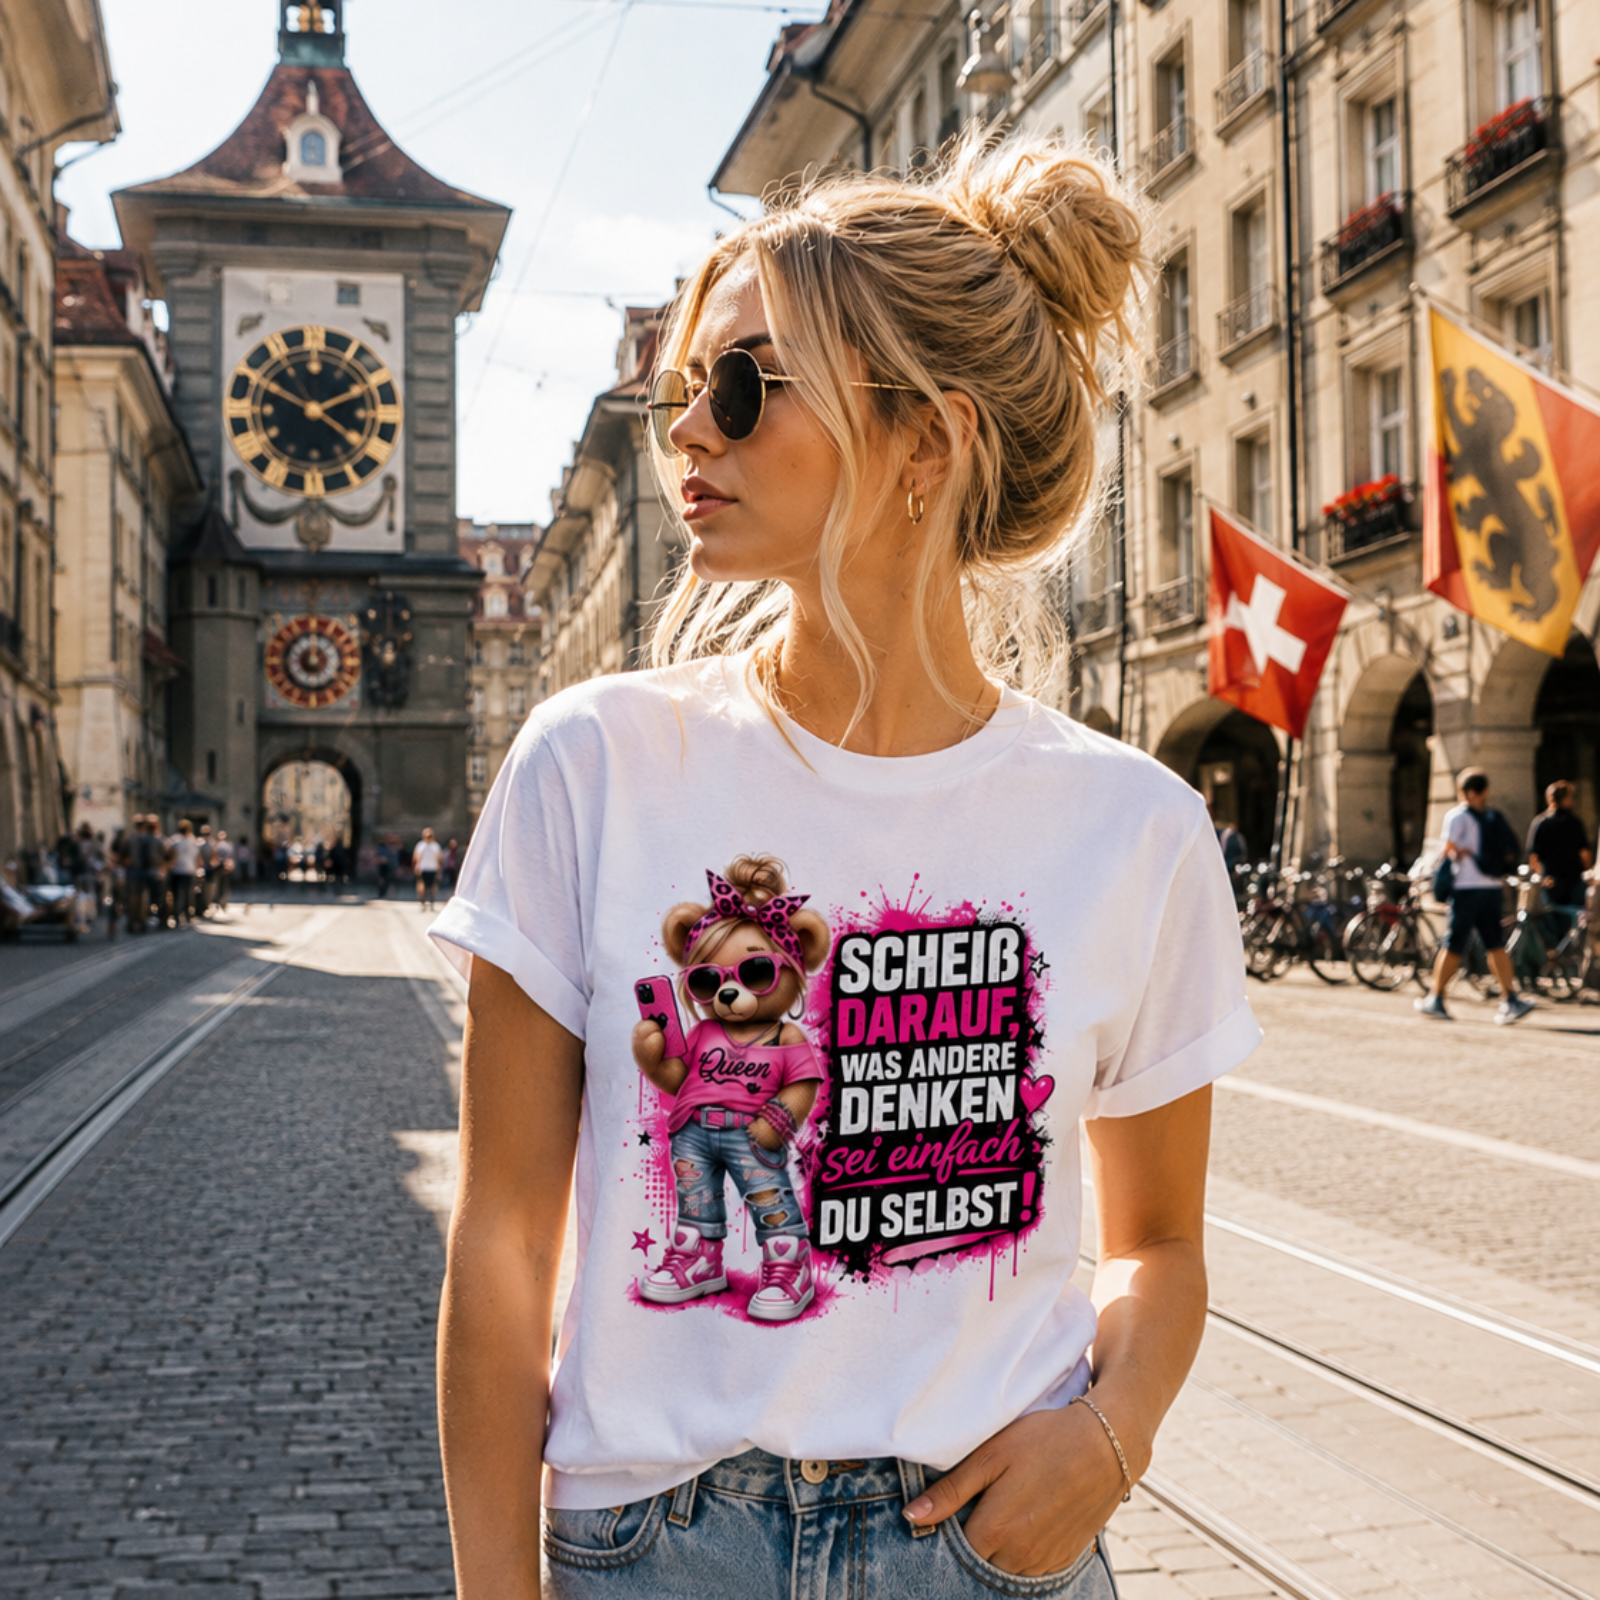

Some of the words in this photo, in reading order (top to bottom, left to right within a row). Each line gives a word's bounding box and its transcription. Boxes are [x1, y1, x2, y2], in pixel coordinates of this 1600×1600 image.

[837, 987, 1019, 1047] DARAUF,
[699, 1047, 771, 1083] Queen
[840, 1050, 902, 1082] WAS
[908, 1041, 1017, 1079] ANDERE
[839, 1074, 1016, 1135] DENKEN
[888, 1117, 1025, 1183] einfach
[819, 1196, 871, 1245] DU
